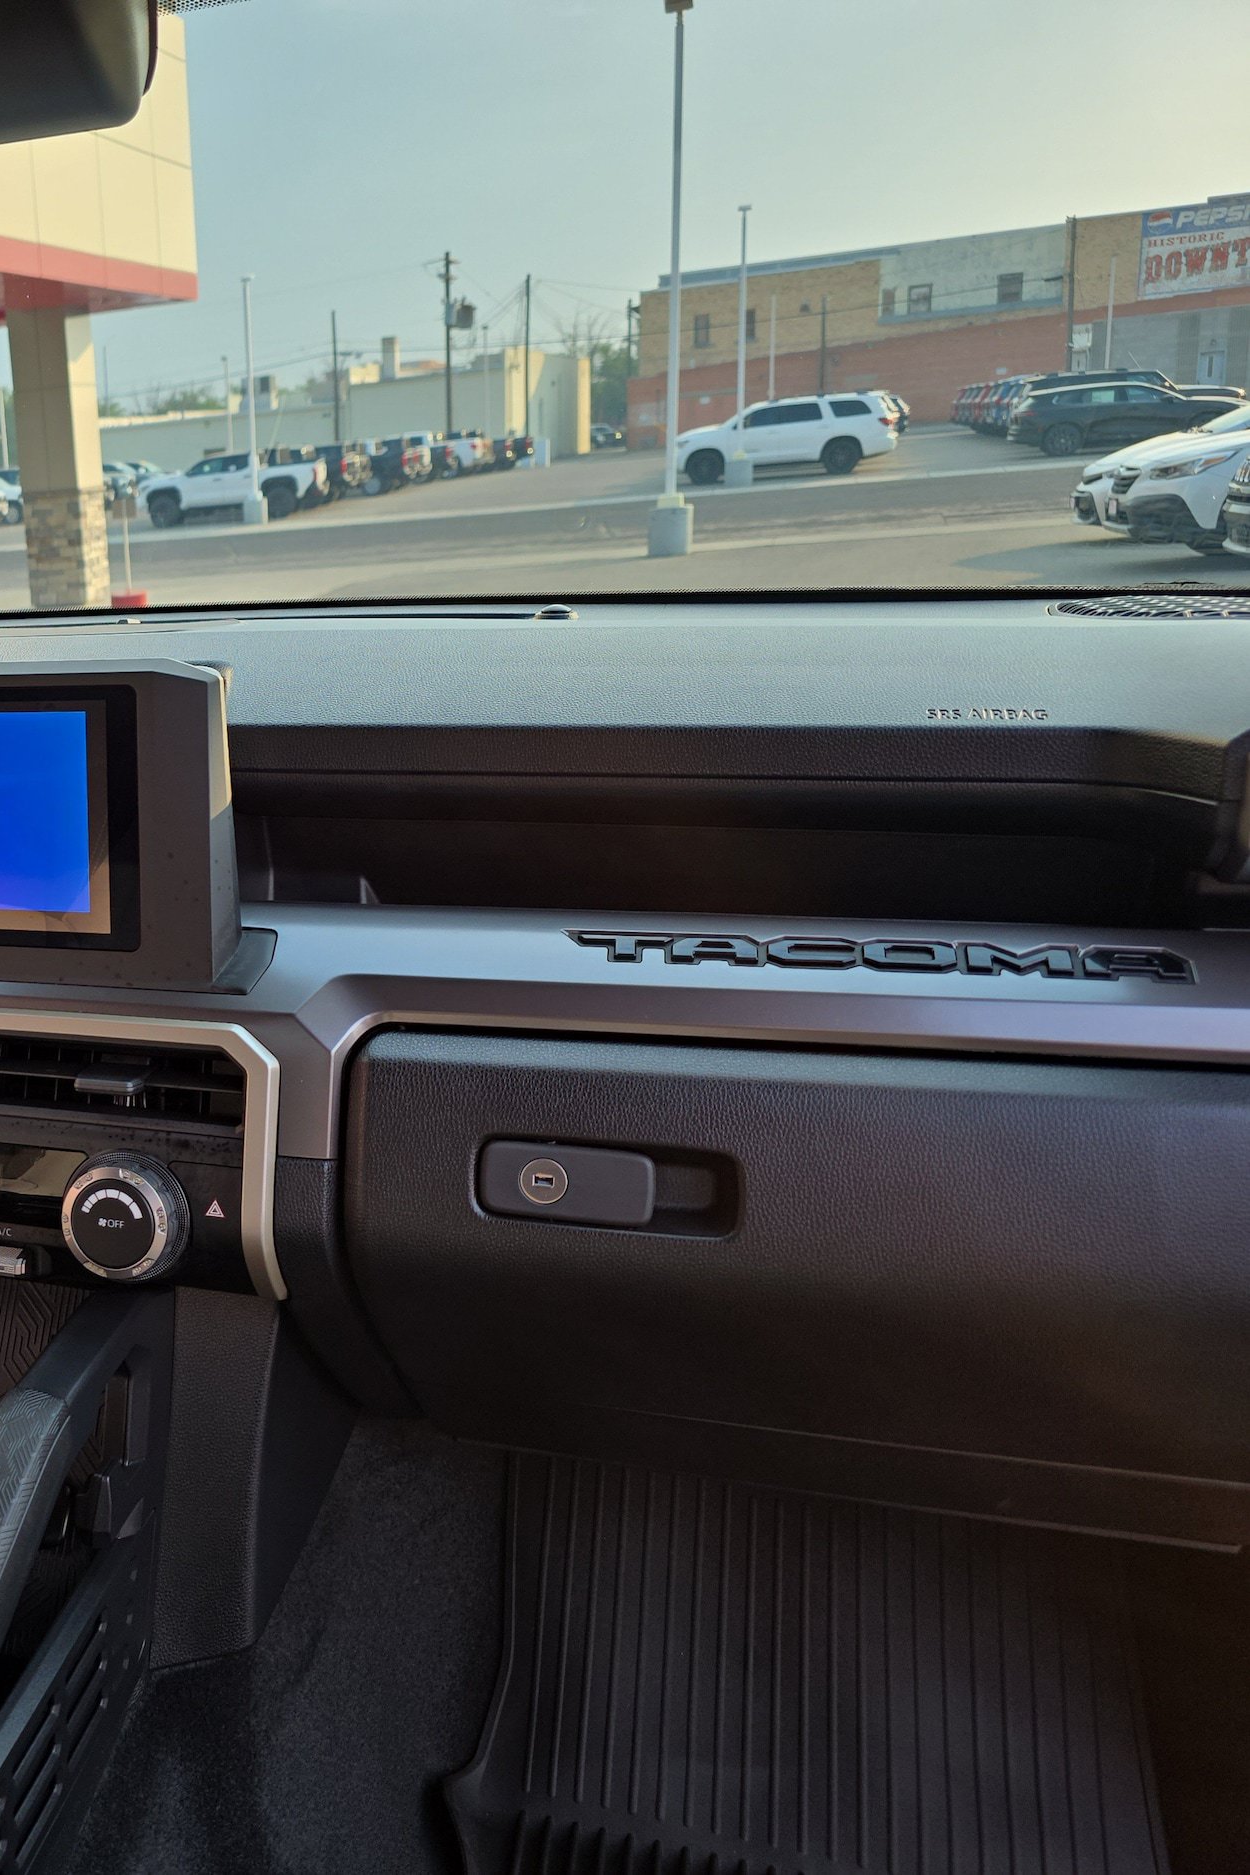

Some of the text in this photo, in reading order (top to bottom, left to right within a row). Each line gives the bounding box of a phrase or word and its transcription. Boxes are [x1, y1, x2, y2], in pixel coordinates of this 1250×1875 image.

[1147, 232, 1225, 248] HISTORIC
[926, 707, 1048, 720] SRS AIRBAG
[561, 927, 1197, 984] TACOMA
[107, 1219, 125, 1229] OFF
